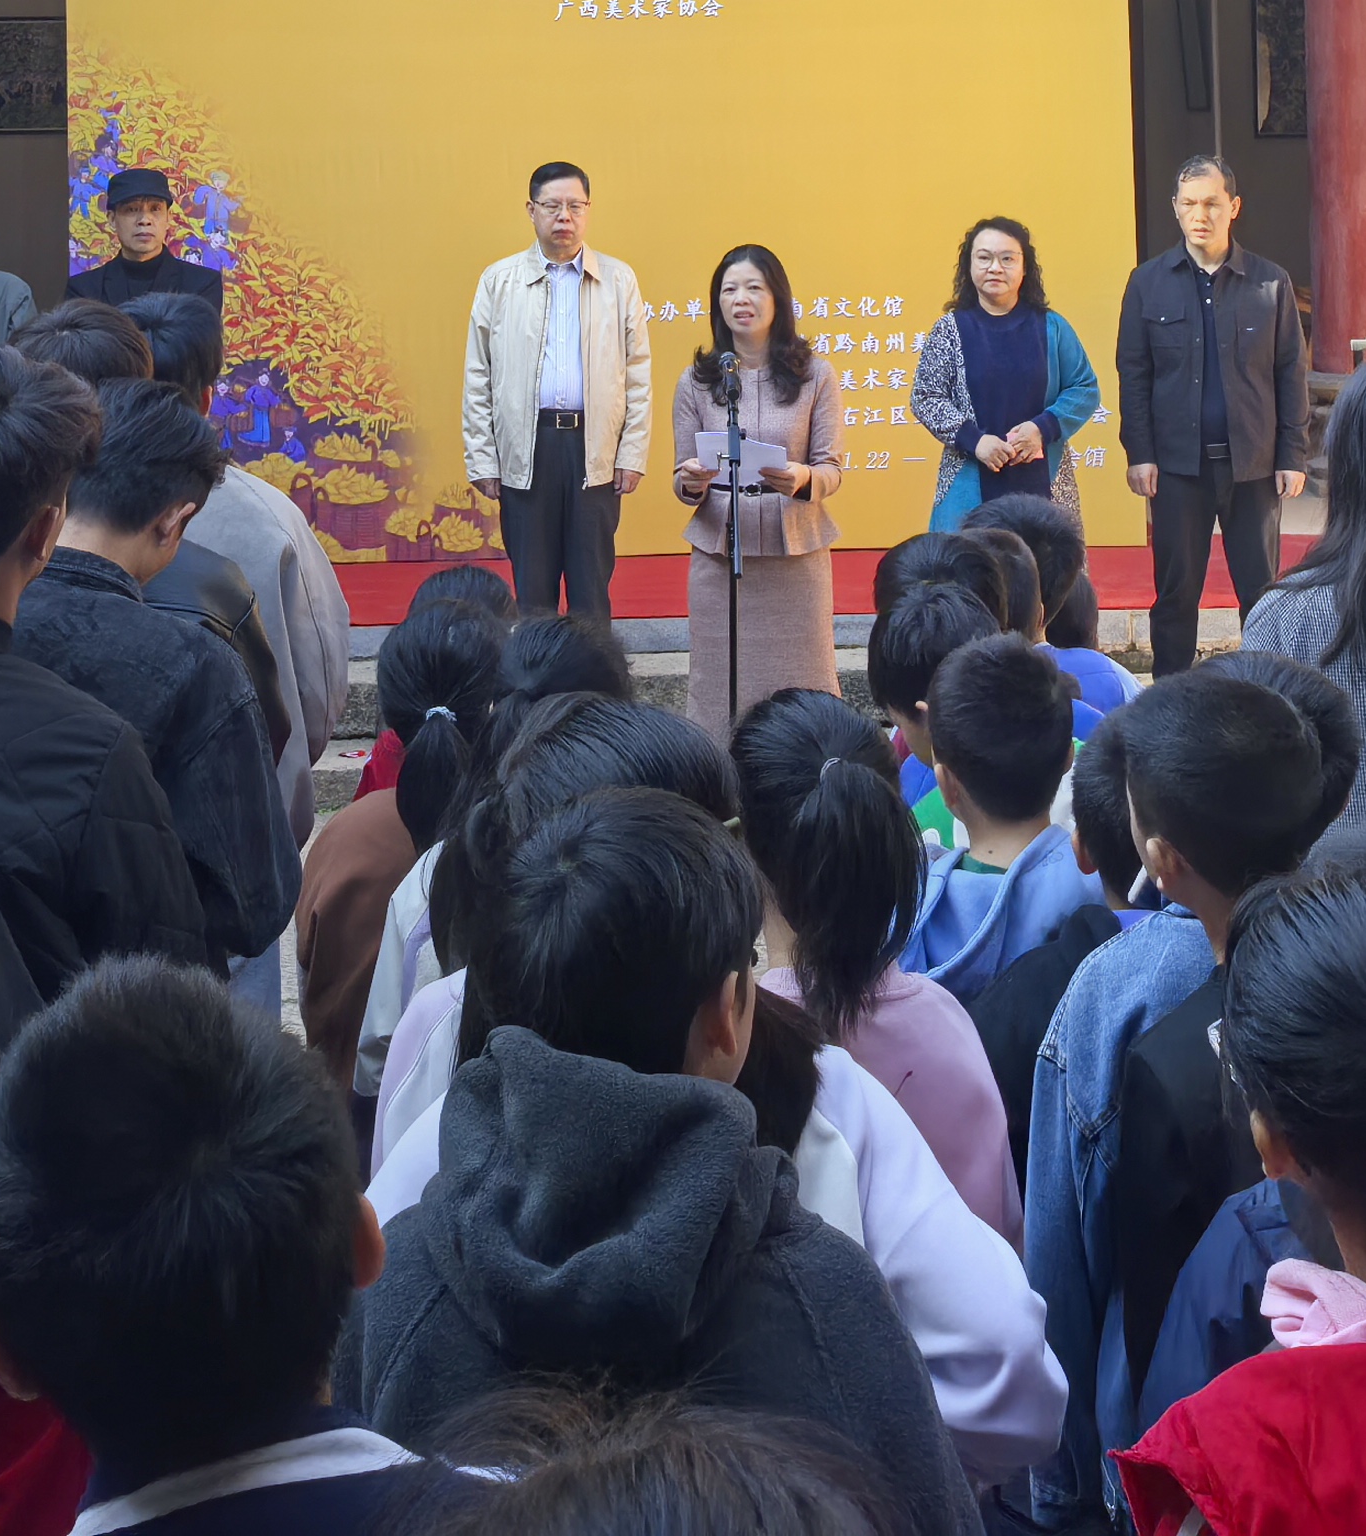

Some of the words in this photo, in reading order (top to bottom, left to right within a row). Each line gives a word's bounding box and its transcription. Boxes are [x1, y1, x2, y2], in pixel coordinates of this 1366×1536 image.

[798, 332, 926, 355] 省黔南州美
[840, 368, 917, 390] 美术家
[843, 406, 922, 426] 右江区
